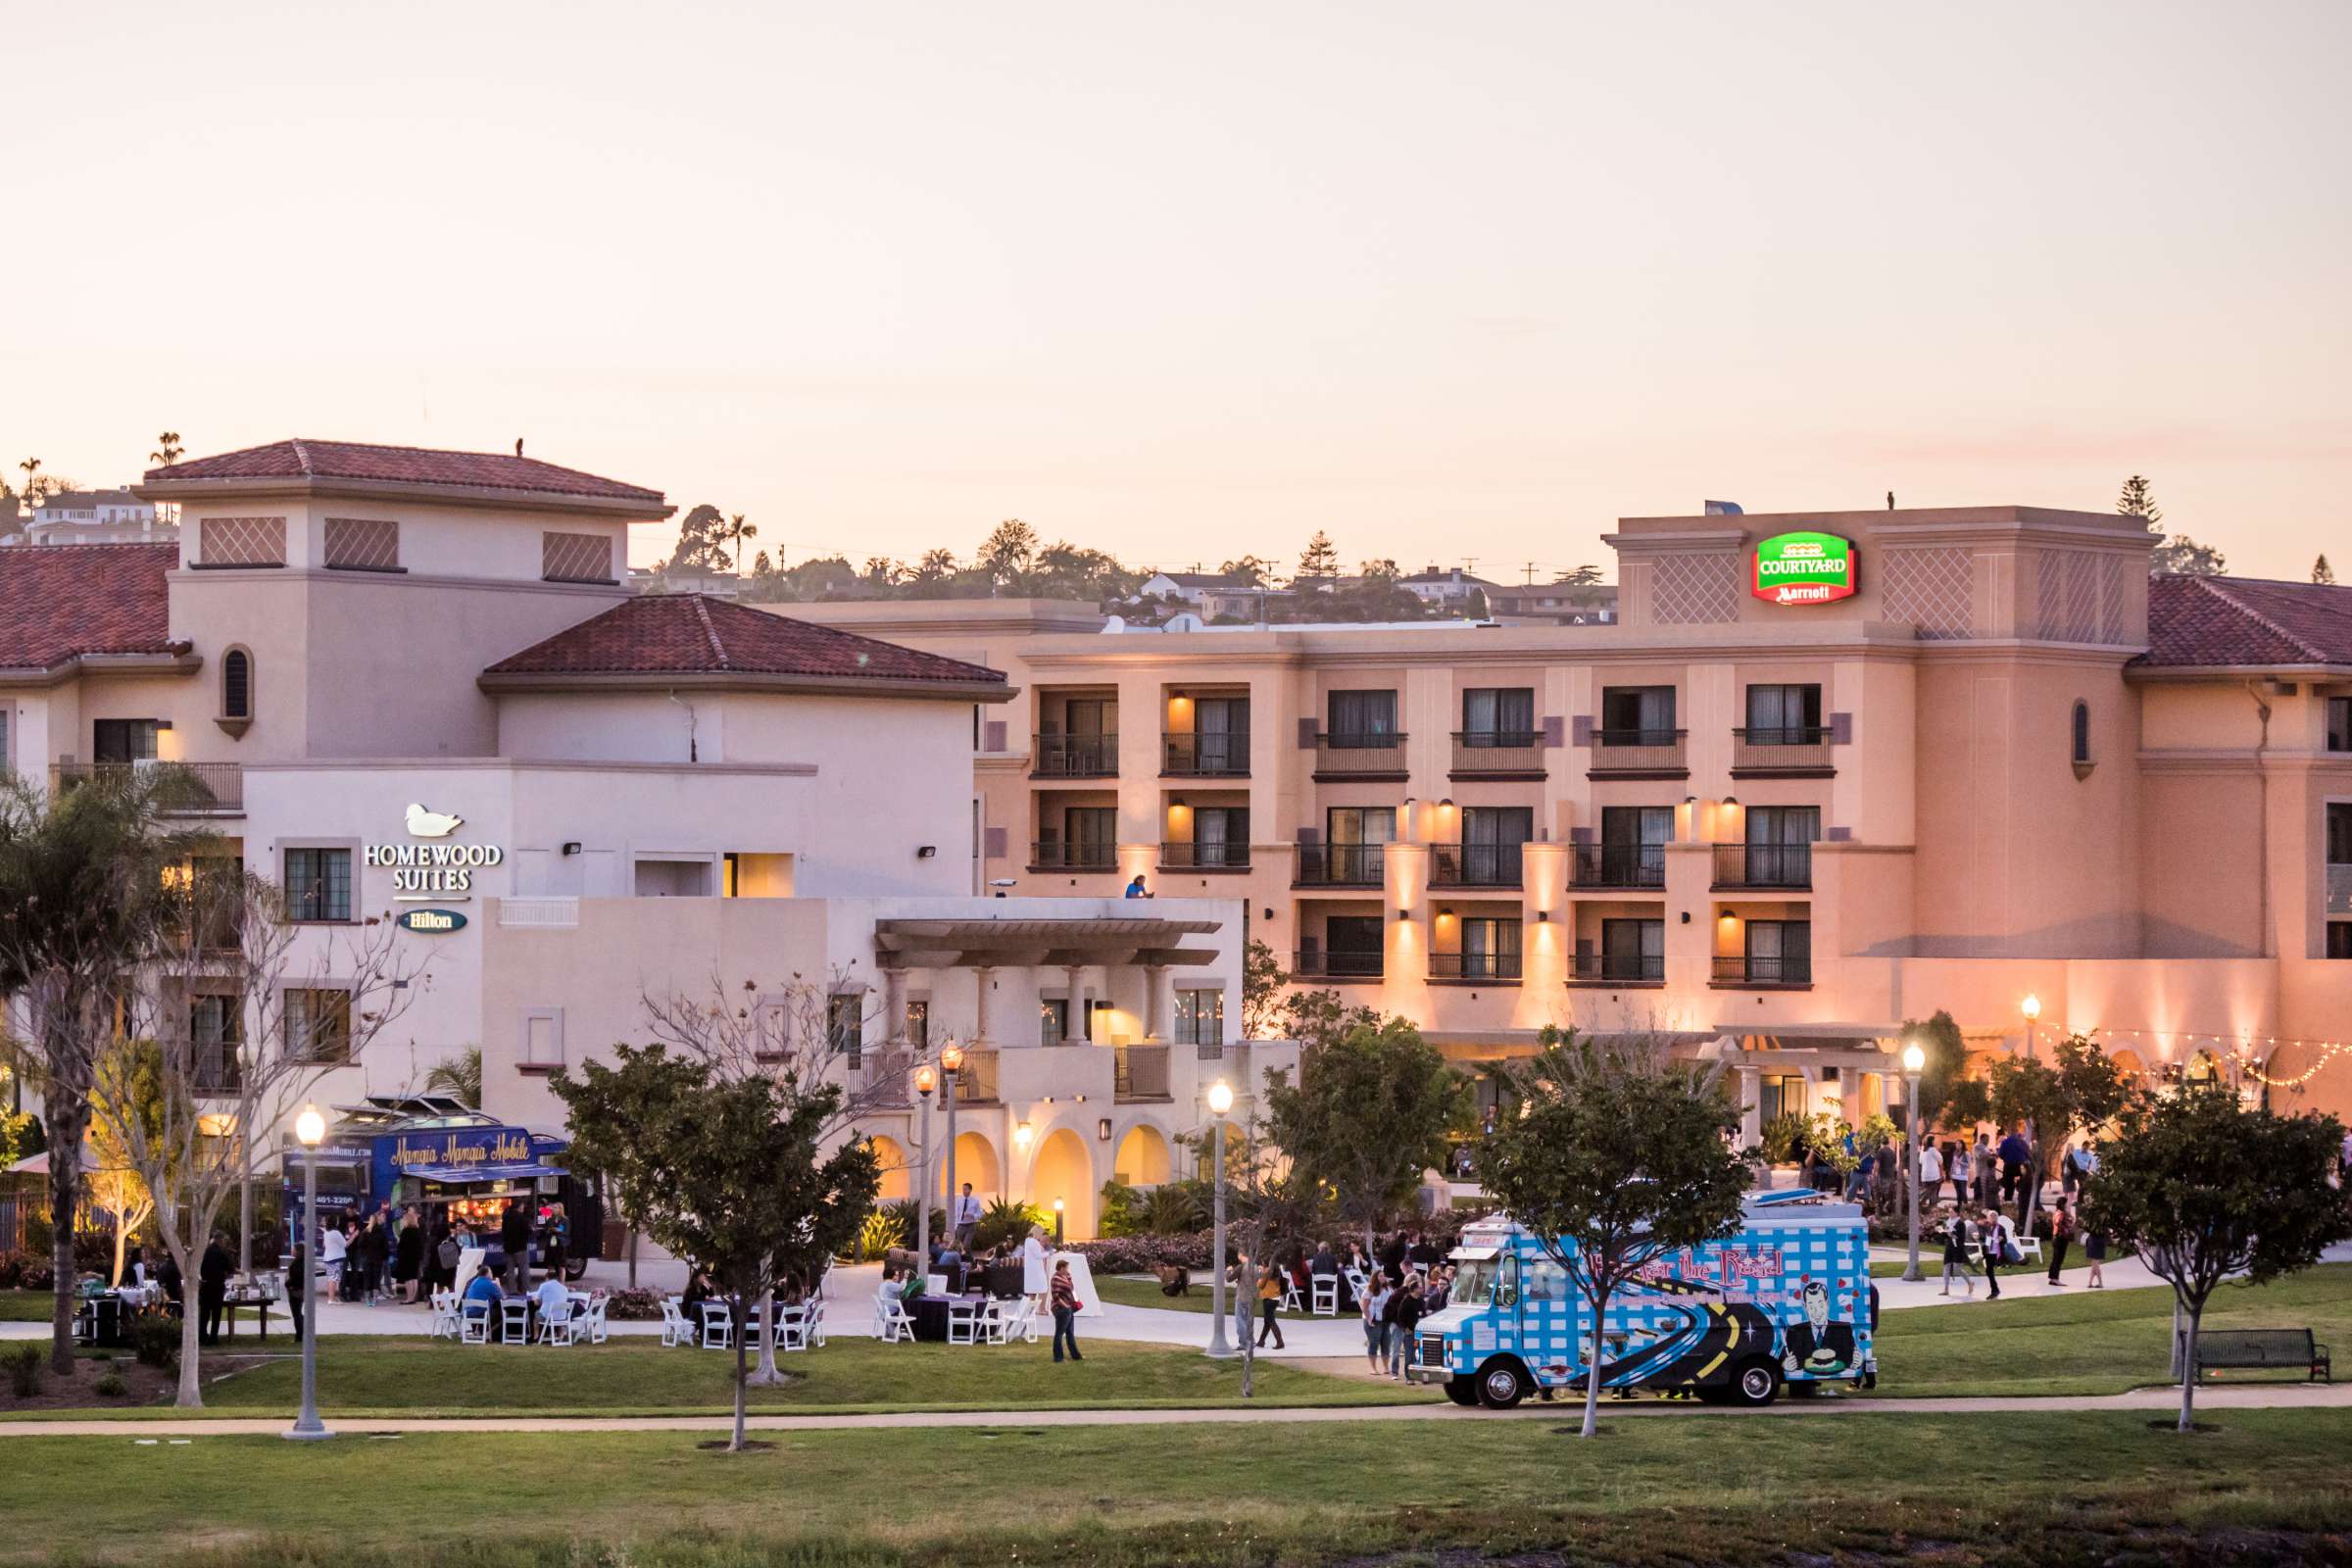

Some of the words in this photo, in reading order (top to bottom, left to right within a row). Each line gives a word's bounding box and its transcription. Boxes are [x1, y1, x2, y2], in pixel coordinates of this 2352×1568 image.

[1760, 559, 1846, 574] COURTYARD
[1776, 586, 1830, 603] Marriott
[364, 845, 503, 866] HOMEWOOD
[394, 869, 470, 891] SUITES
[410, 912, 453, 928] Hilton
[390, 1136, 437, 1169] Mangia
[441, 1134, 487, 1168] Mangia
[490, 1132, 530, 1165] Mobile
[1679, 1252, 1710, 1280] the
[1719, 1249, 1784, 1287] Road
